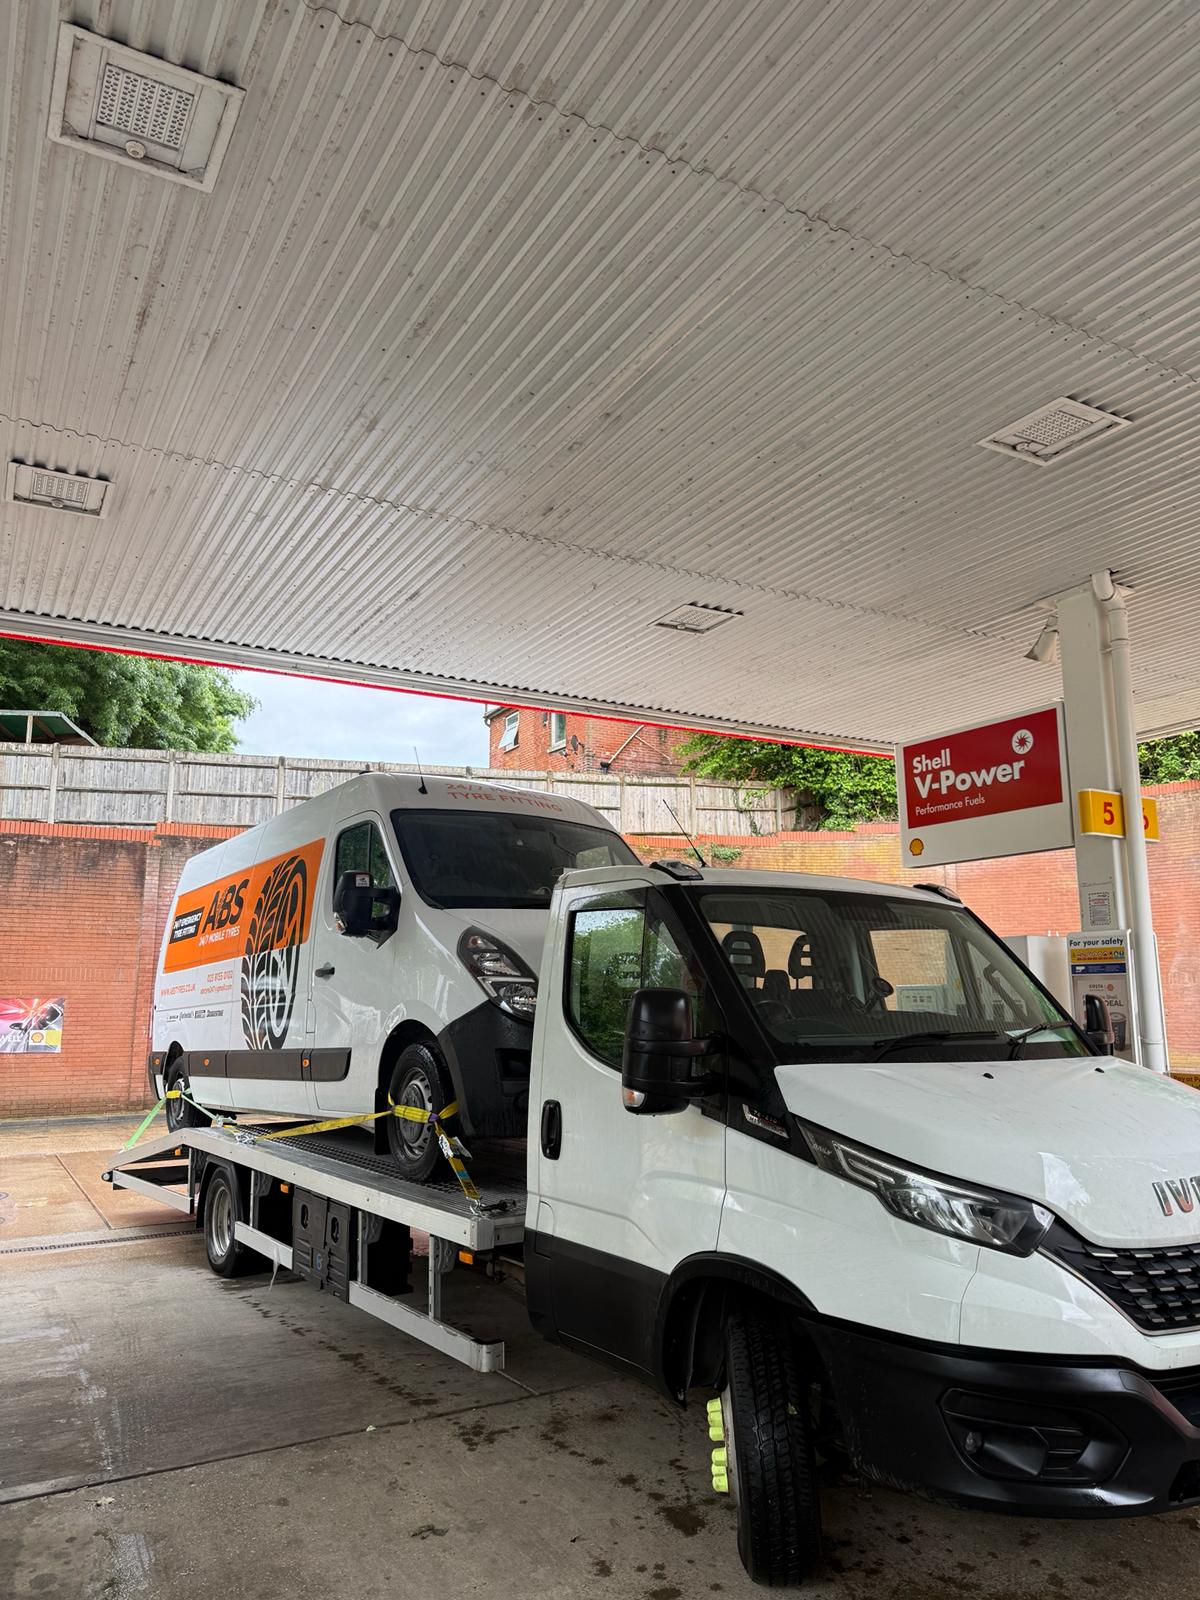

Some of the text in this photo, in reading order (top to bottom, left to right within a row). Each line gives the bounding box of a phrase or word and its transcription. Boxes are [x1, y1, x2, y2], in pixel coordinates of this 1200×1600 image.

[912, 748, 951, 774] Shell
[914, 760, 1025, 799] V-Power
[447, 791, 562, 812] TYRE FITTING
[915, 793, 985, 816] Performance Fuels
[1103, 801, 1115, 826] 5
[201, 878, 250, 934] ABS
[226, 926, 240, 938] TYRES
[1083, 939, 1100, 947] your
[1101, 937, 1124, 945] safety
